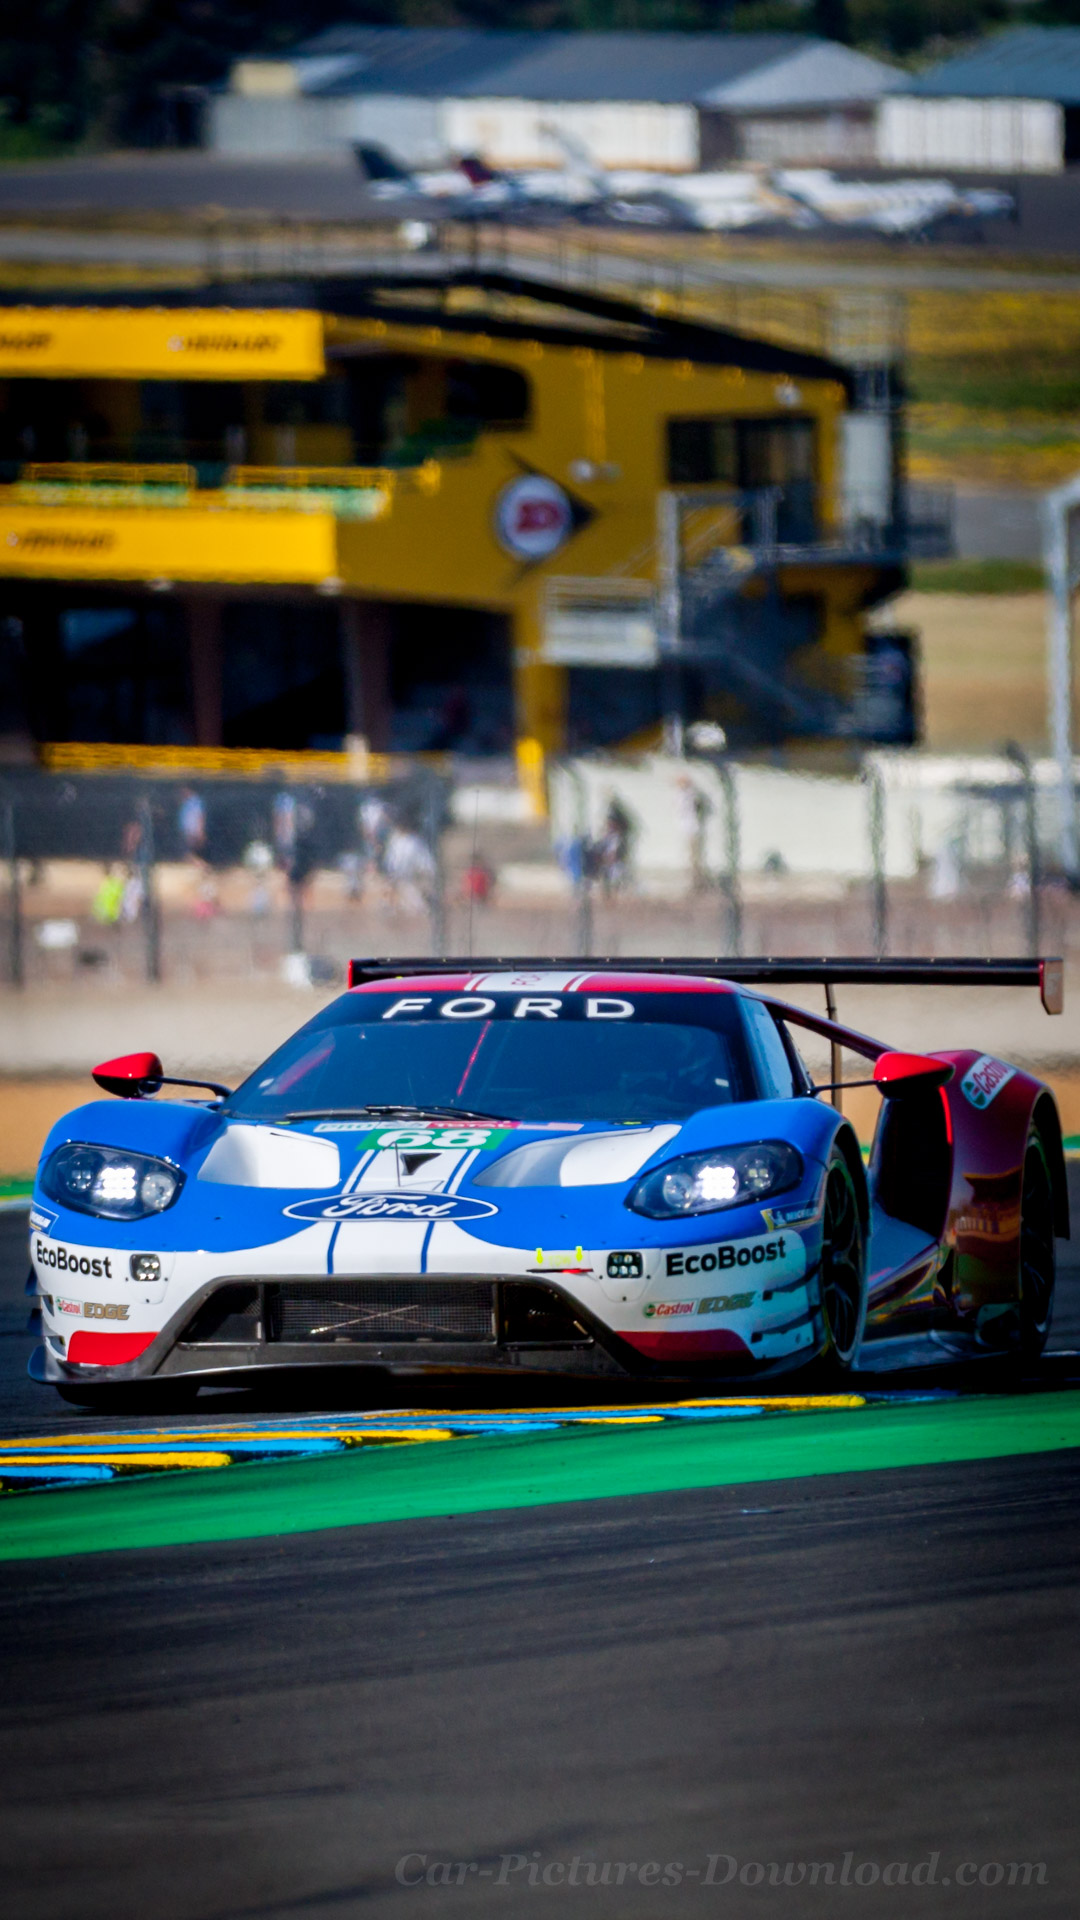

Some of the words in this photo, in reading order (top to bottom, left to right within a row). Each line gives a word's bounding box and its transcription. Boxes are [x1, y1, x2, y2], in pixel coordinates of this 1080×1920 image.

[382, 998, 635, 1019] FORD
[377, 1129, 488, 1148] 68
[322, 1194, 458, 1217] Ford
[36, 1239, 112, 1278] EcoBoost
[666, 1237, 786, 1277] EcoBoost
[84, 1301, 131, 1321] EDGE
[656, 1301, 695, 1316] Castrol
